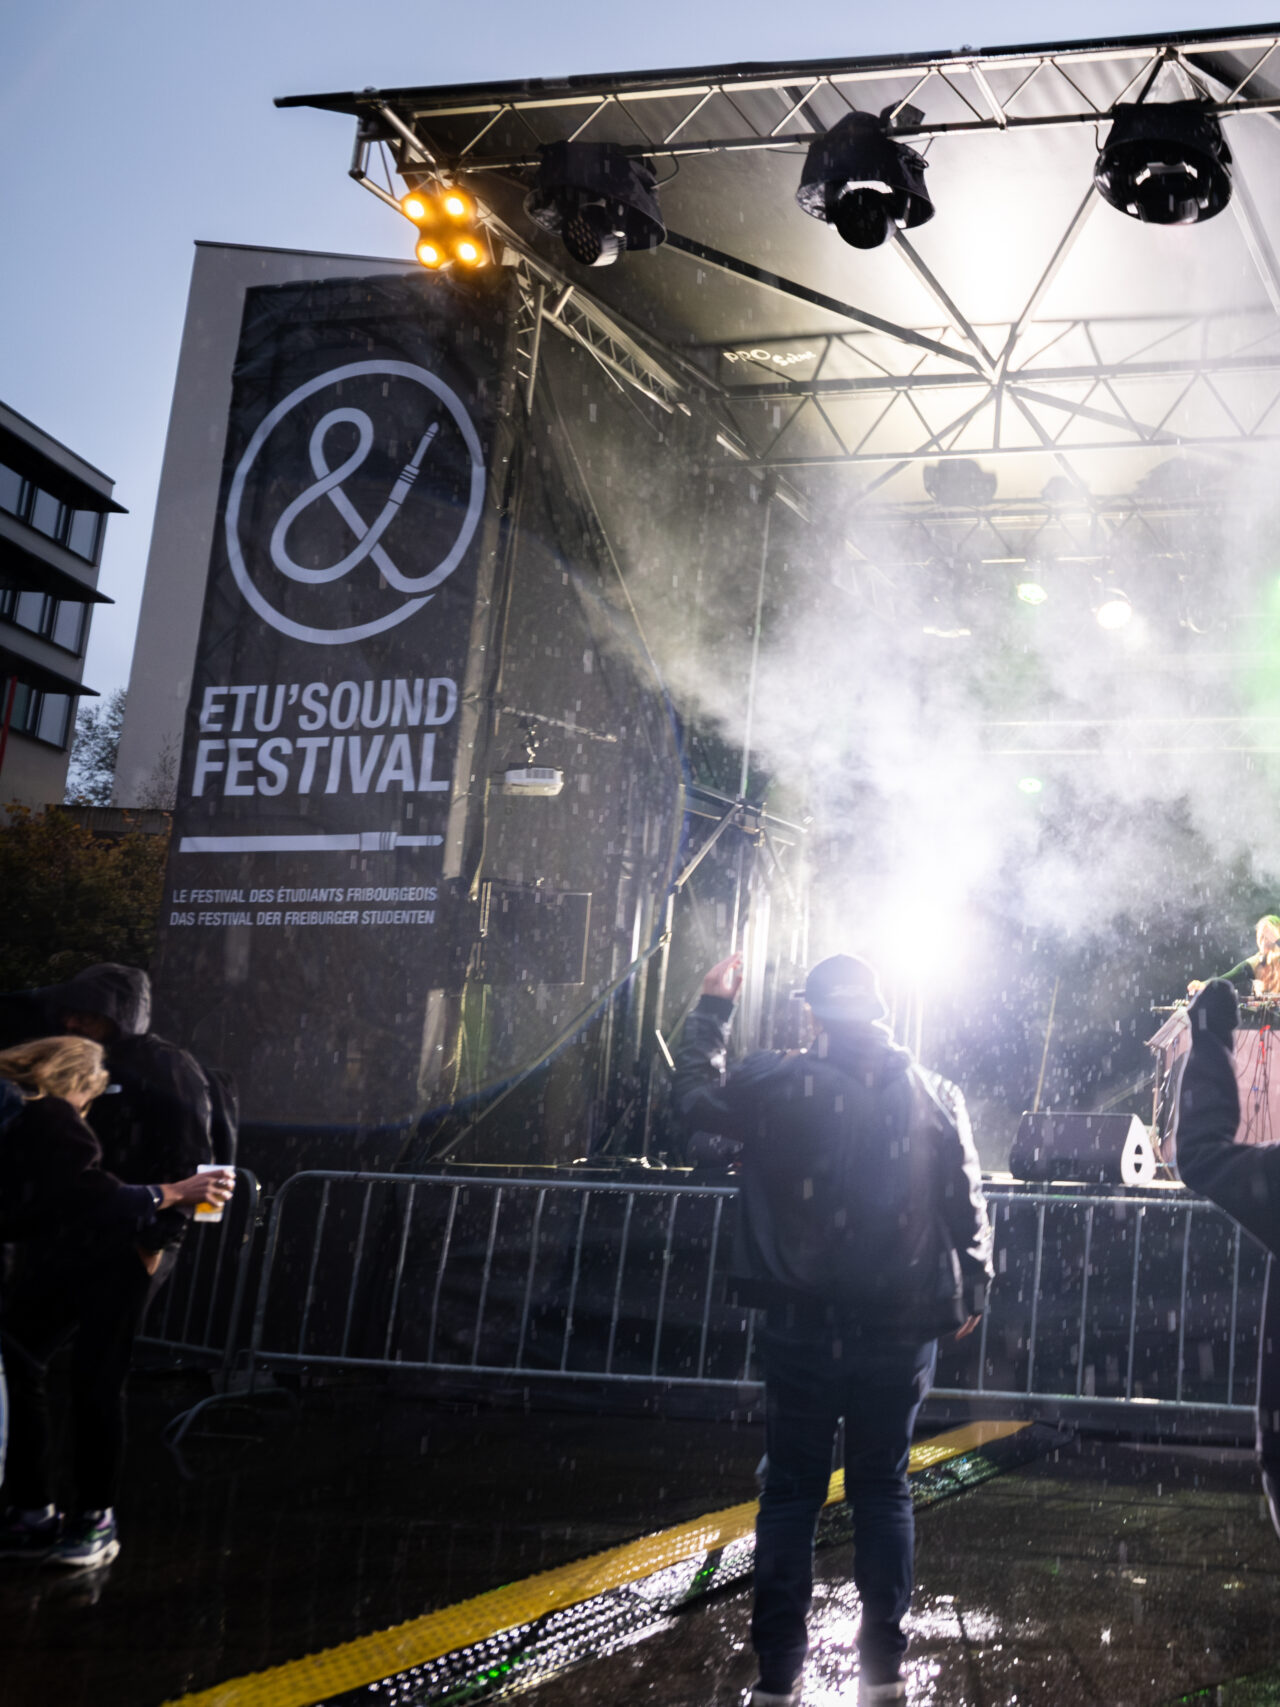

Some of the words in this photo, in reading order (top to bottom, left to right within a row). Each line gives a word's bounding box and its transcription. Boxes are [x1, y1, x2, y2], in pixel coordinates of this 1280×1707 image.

[200, 677, 458, 732] ETU'SOUND
[192, 733, 450, 796] FESTIVAL
[172, 889, 188, 904] LE
[189, 888, 246, 904] FESTIVAL
[250, 888, 275, 903] DES
[346, 886, 438, 902] FRIBOURGEOIS
[169, 911, 196, 926] DAS
[197, 911, 253, 926] FESTIVAL
[256, 911, 282, 926] DER
[284, 910, 359, 925] FREIBURGER
[361, 909, 435, 925] STUDENTEN
